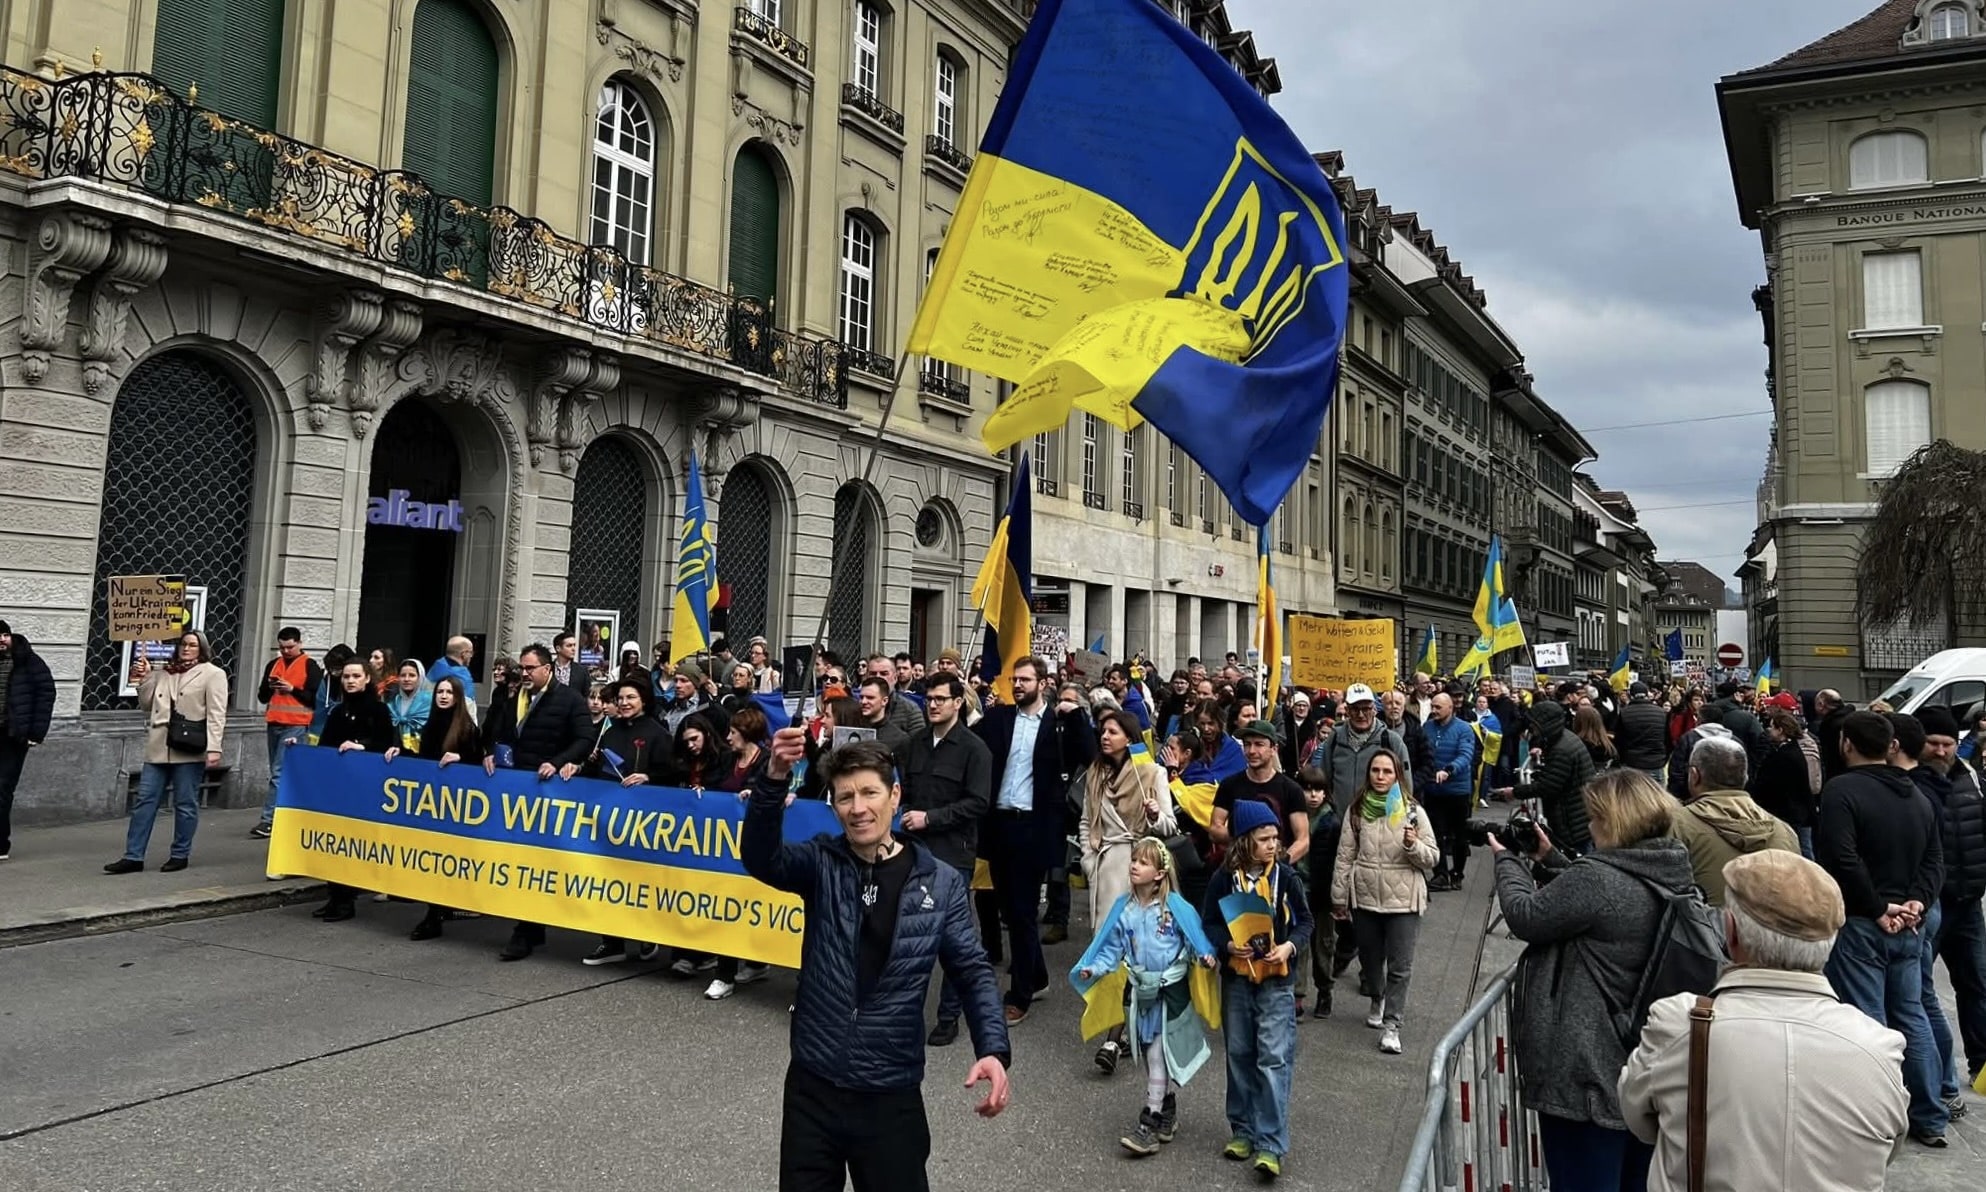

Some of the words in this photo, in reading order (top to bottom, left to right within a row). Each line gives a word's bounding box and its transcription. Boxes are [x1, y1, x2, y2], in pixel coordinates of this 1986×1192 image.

[1837, 213, 1905, 226] BANQUE
[1913, 206, 1986, 220] NATIONA
[367, 489, 464, 532] aliant
[111, 579, 139, 597] Nur
[140, 586, 153, 595] ein
[156, 578, 182, 600] Sieg
[112, 599, 128, 608] der
[130, 597, 183, 609] Ukraine
[113, 609, 136, 620] kann
[136, 608, 177, 620] Frieden
[114, 620, 160, 636] bringen
[1299, 620, 1323, 632] Mehr
[1325, 622, 1357, 638] Waffen
[1364, 624, 1385, 636] Geld
[1315, 640, 1332, 652] die
[1338, 642, 1384, 655] Ukraine
[1347, 656, 1387, 671] Frieden
[381, 777, 490, 826] STAND
[501, 793, 601, 842] WITH
[606, 807, 744, 861] UKRAIN
[300, 828, 396, 866] UKRANIAN
[400, 845, 486, 883] VICTORY
[488, 861, 509, 887] IS
[516, 864, 559, 895] THE
[564, 872, 650, 910] WHOLE
[655, 886, 763, 927] WORLD'S
[768, 902, 803, 934] VIC
